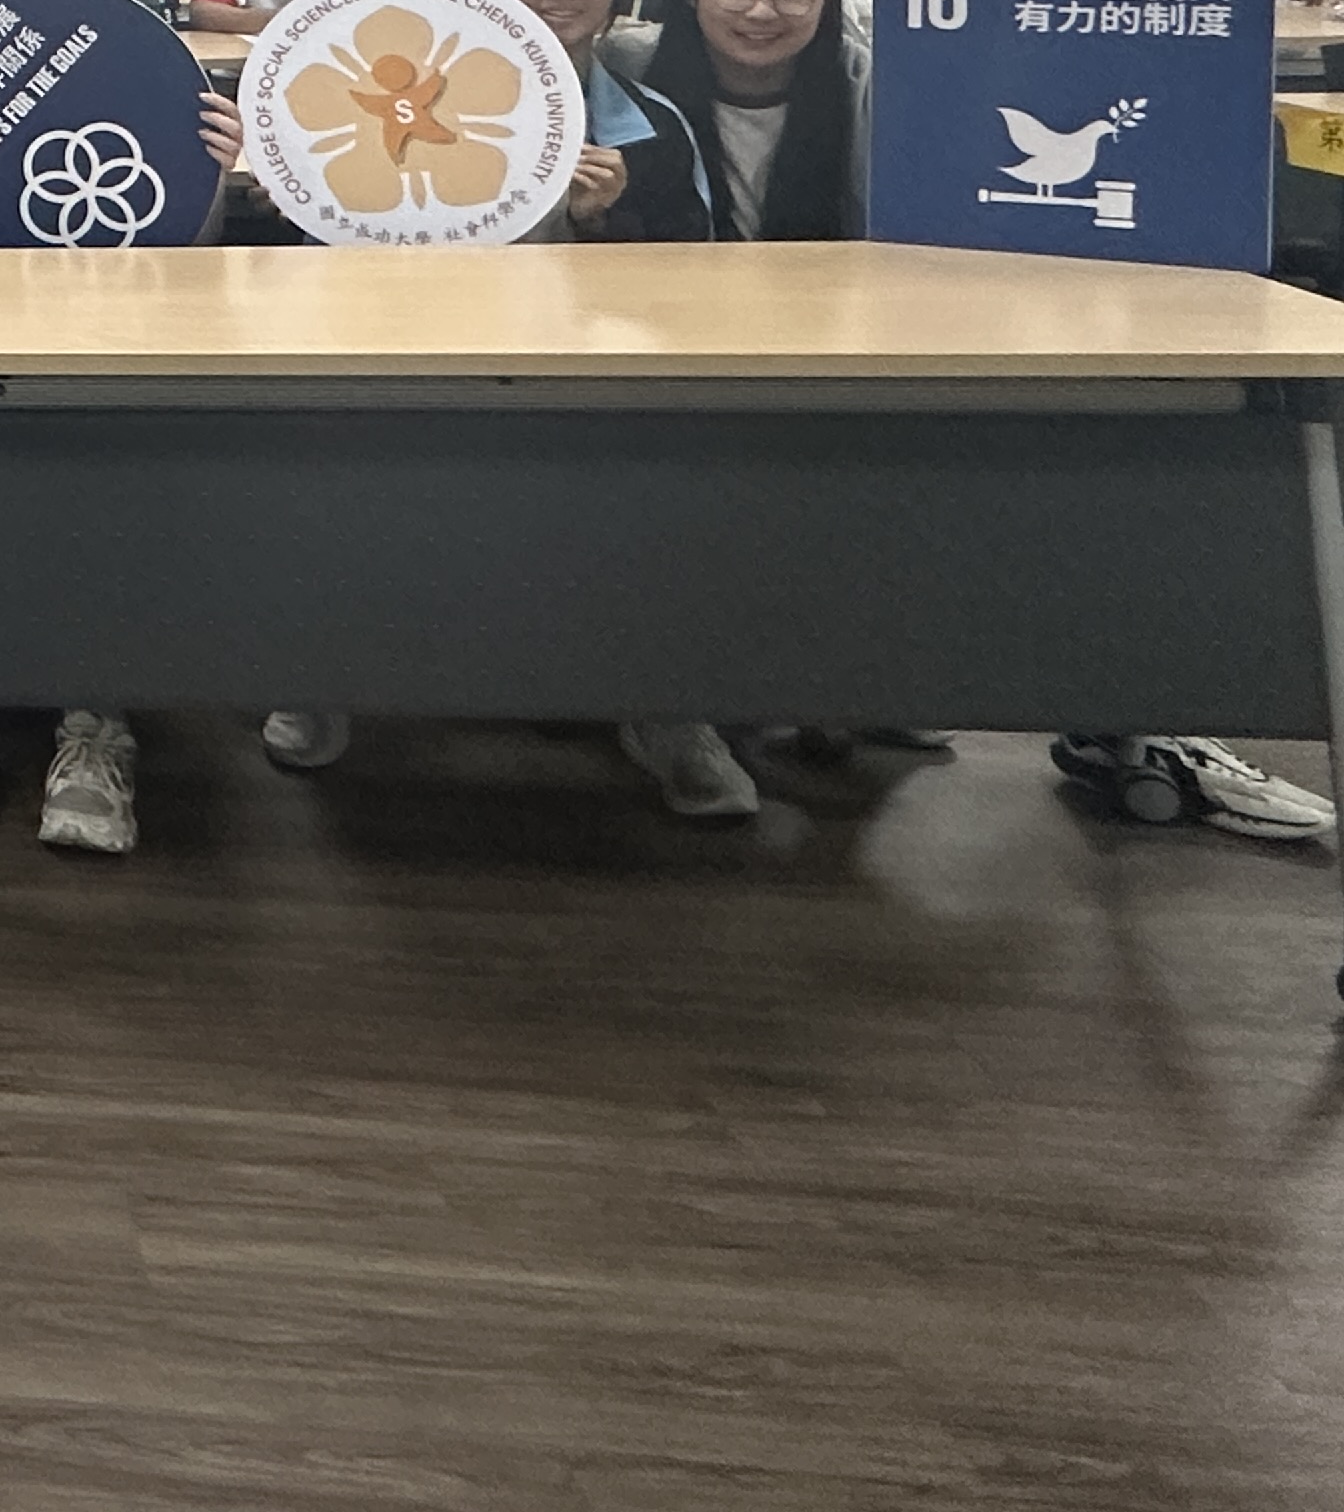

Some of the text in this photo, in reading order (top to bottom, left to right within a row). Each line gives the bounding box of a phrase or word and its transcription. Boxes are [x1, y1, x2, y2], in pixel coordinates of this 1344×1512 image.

[1014, 1, 1233, 37] 有力的制度
[1, 91, 37, 125] FOR
[25, 64, 60, 98] THE
[49, 24, 98, 74] GOALS
[257, 42, 293, 101] SOCIAL
[522, 39, 558, 88] KUNG
[256, 105, 272, 128] OF
[394, 99, 415, 124] S
[529, 92, 566, 185] UNIVERSITY
[263, 132, 311, 205] COLLEGE
